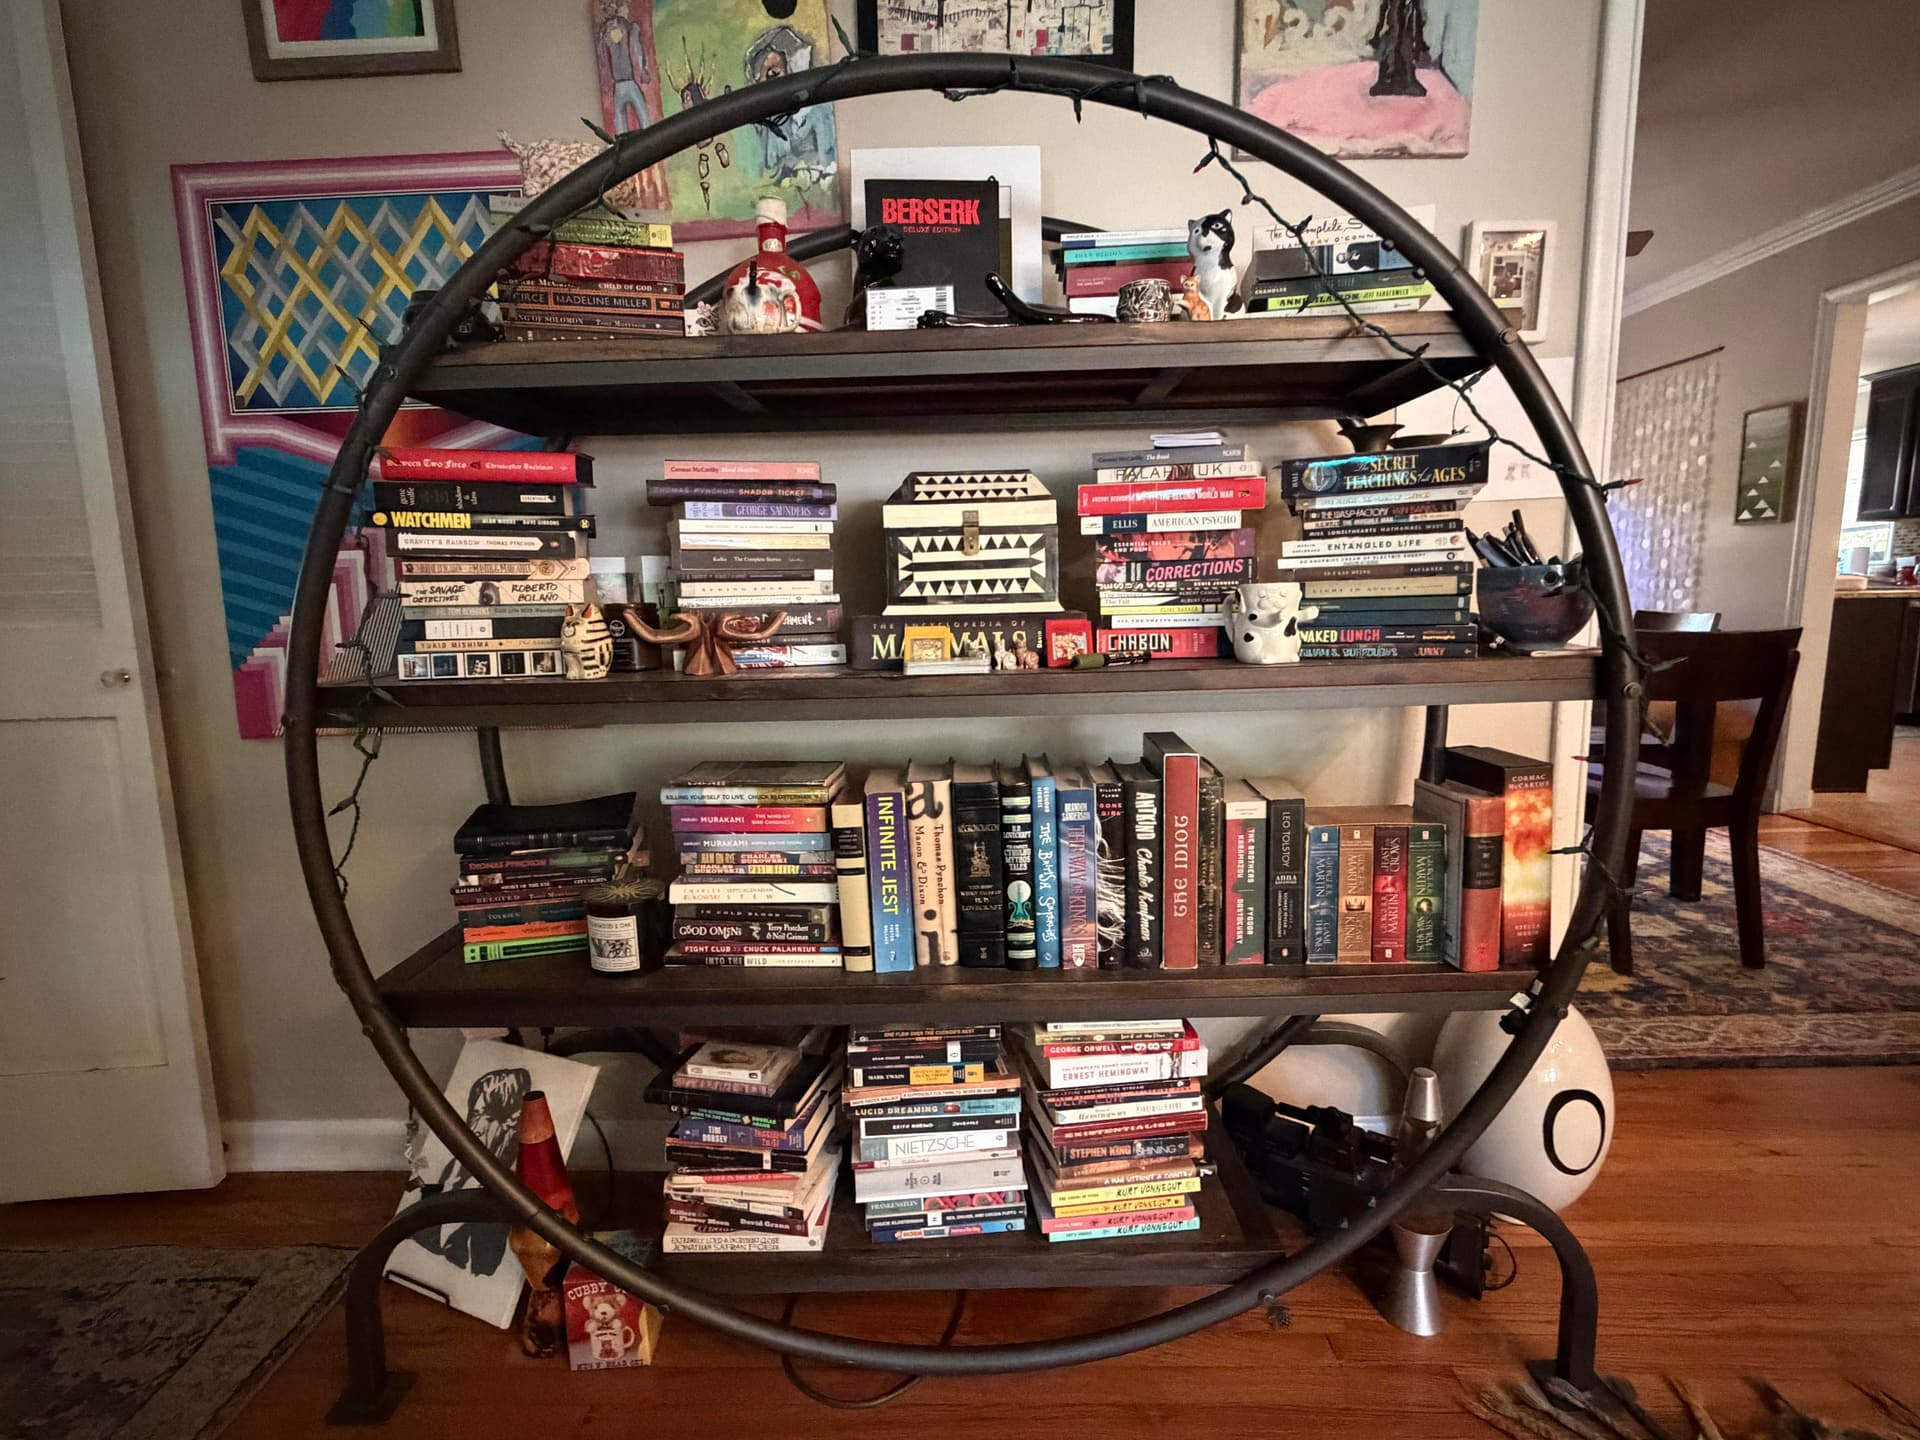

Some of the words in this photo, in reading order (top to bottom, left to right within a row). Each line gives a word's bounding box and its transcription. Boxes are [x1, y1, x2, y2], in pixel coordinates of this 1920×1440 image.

[882, 198, 980, 225] BERSERK
[1266, 227, 1283, 240] The
[513, 292, 545, 303] CIRCE
[555, 294, 611, 306] MADELINE
[613, 298, 648, 308] MILLER
[422, 458, 443, 468] Two
[1370, 455, 1419, 471] SECRET
[1344, 469, 1417, 491] TEACHINGS
[1432, 466, 1466, 483] AGES
[736, 505, 768, 516] GEORGE
[770, 504, 811, 516] SAUNDERS
[390, 512, 471, 528] WATCHMEN
[1113, 519, 1138, 528] ELLIS
[1152, 516, 1200, 527] AMERICAN
[1202, 514, 1237, 525] PSYCHO
[1328, 541, 1392, 551] ENTANGLED
[1398, 539, 1421, 548] LIFE
[1146, 559, 1244, 582] CORRECTIONS
[429, 585, 465, 594] SAVAGE
[512, 583, 557, 592] ROBERTO
[412, 595, 459, 603] DETECTIVES
[1108, 633, 1173, 652] CHABON
[1340, 629, 1380, 642] LUNCH
[1512, 774, 1547, 782] CORMAC
[700, 816, 745, 824] MURAKAMI
[1135, 792, 1156, 841] ANTKIND
[1282, 811, 1291, 829] LEO
[878, 797, 897, 871] INFINITE
[914, 825, 925, 858] Mason
[1068, 825, 1085, 848] THE
[934, 824, 944, 862] Thomas
[1174, 815, 1188, 869] IDIOT
[1282, 831, 1292, 868] TOLSTOY
[1069, 850, 1086, 881] WAY
[1136, 848, 1153, 890] Charlie
[918, 875, 929, 905] Dixon
[935, 865, 948, 905] Pynchon
[881, 876, 899, 915] JEST
[1069, 896, 1087, 935] KINGS
[679, 925, 707, 936] GOOD
[705, 955, 725, 965] INTO
[727, 955, 742, 965] THE
[746, 955, 767, 965] WILD
[1050, 1045, 1082, 1053] GEORGE
[1084, 1044, 1116, 1052] ORWELL
[1063, 1071, 1095, 1081] ERNEST
[1099, 1067, 1149, 1078] HEMINGWAY
[855, 1108, 884, 1116] LUCID
[888, 1105, 938, 1115] DREAMING
[708, 1125, 721, 1134] TIM
[1065, 1121, 1176, 1138] EXISTENTIALISM
[702, 1134, 728, 1143] DORSEY
[895, 1135, 975, 1155] NIETZSCHE
[1070, 1147, 1107, 1159] STEPHEN
[1110, 1145, 1131, 1156] KING
[1116, 1186, 1138, 1197] KURT
[1140, 1182, 1182, 1194] VONNEGUT
[1113, 1202, 1132, 1212] KURT
[1134, 1199, 1171, 1209] VONNEGUT
[740, 1218, 763, 1227] David
[764, 1221, 790, 1230] Grann
[1108, 1215, 1129, 1225] KURT
[1132, 1212, 1174, 1222] VONNEGUT
[1117, 1225, 1139, 1234] KURT
[1141, 1222, 1183, 1232] VONNEGUT
[567, 1282, 608, 1300] CUBBY
